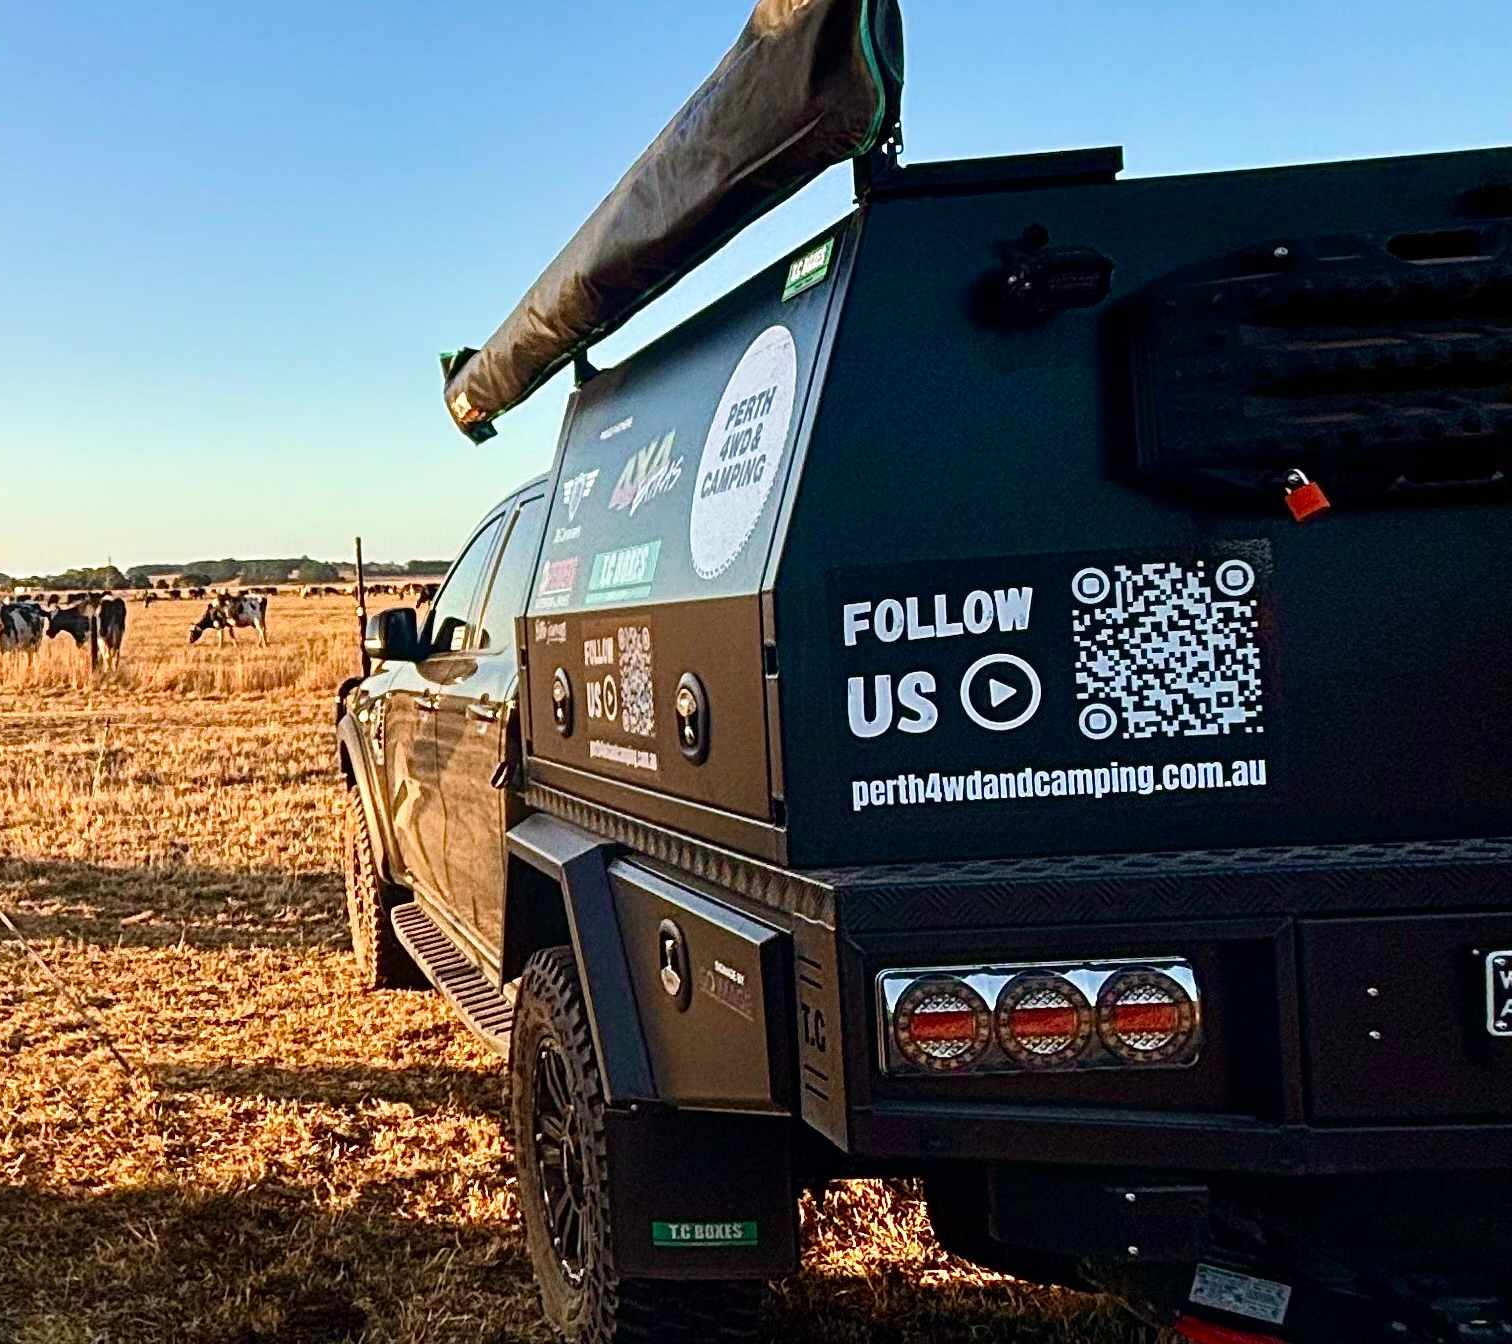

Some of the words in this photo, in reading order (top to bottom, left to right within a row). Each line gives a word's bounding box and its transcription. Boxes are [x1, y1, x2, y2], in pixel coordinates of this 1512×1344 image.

[725, 386, 778, 431] PERTH
[719, 422, 764, 462] 4WD&
[701, 454, 766, 498] CAMPING
[843, 586, 1033, 647] FOLLOW
[586, 681, 603, 720] US
[847, 671, 938, 738] US
[851, 759, 1267, 811] perth4wdandcamping.com.au
[694, 1222, 744, 1240] BOXES
